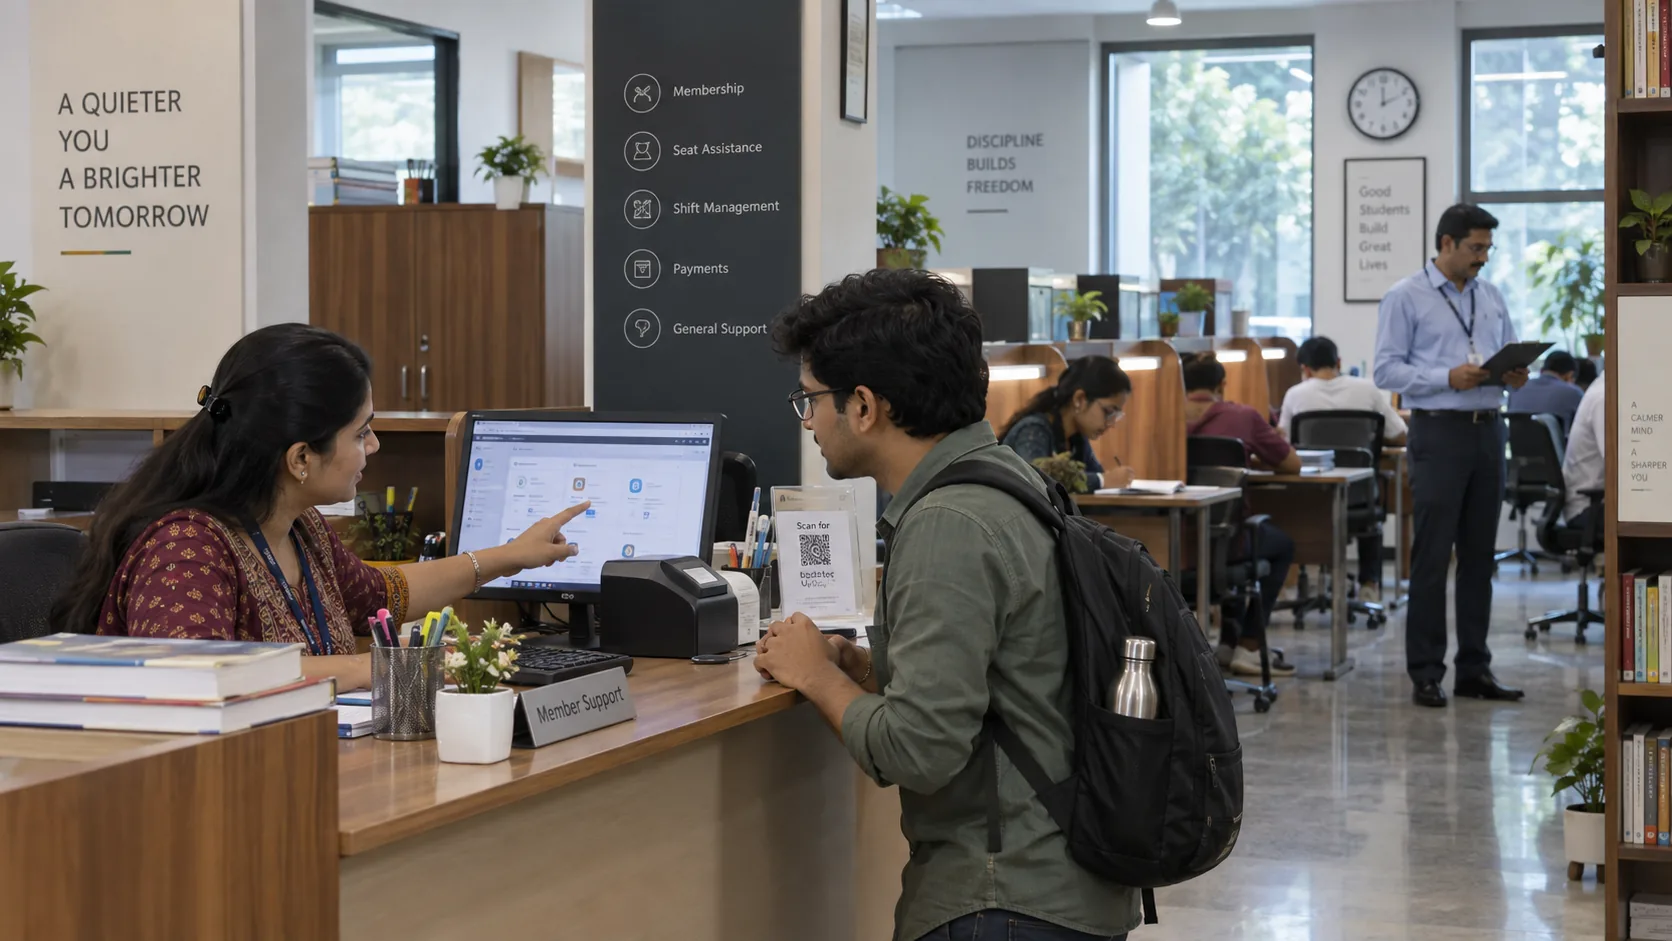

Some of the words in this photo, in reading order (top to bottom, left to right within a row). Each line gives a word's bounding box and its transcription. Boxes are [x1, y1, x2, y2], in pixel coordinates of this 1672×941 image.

[673, 82, 745, 98] Membership
[57, 92, 74, 115] A
[82, 89, 182, 117] QUIETER
[58, 129, 109, 153] YOU
[966, 132, 1043, 149] DISCIPLINE
[673, 143, 699, 157] Seat
[701, 141, 763, 155] Assistance
[966, 156, 1017, 172] BUILDS
[58, 167, 75, 190] A
[84, 164, 201, 190] BRIGHTER
[966, 179, 1034, 194] FREEDOM
[1358, 185, 1392, 198] Good
[673, 201, 700, 215] Shift
[703, 199, 780, 216] Management
[1359, 204, 1411, 216] Students
[59, 204, 210, 229] TOMORROW
[1359, 222, 1389, 235] Build
[1358, 240, 1392, 253] Great
[673, 262, 729, 277] Payments
[1358, 259, 1389, 271] Lives
[673, 322, 718, 335] General
[720, 322, 768, 337] Support
[1630, 401, 1638, 409] A
[1630, 413, 1664, 422] CALMER
[1630, 426, 1654, 435] MIND
[1630, 448, 1637, 456] A
[1630, 460, 1668, 470] SHARPER
[1630, 473, 1649, 483] YOU
[796, 521, 817, 531] Scan
[818, 520, 831, 530] for
[536, 699, 580, 724] Member
[581, 686, 625, 713] Support
